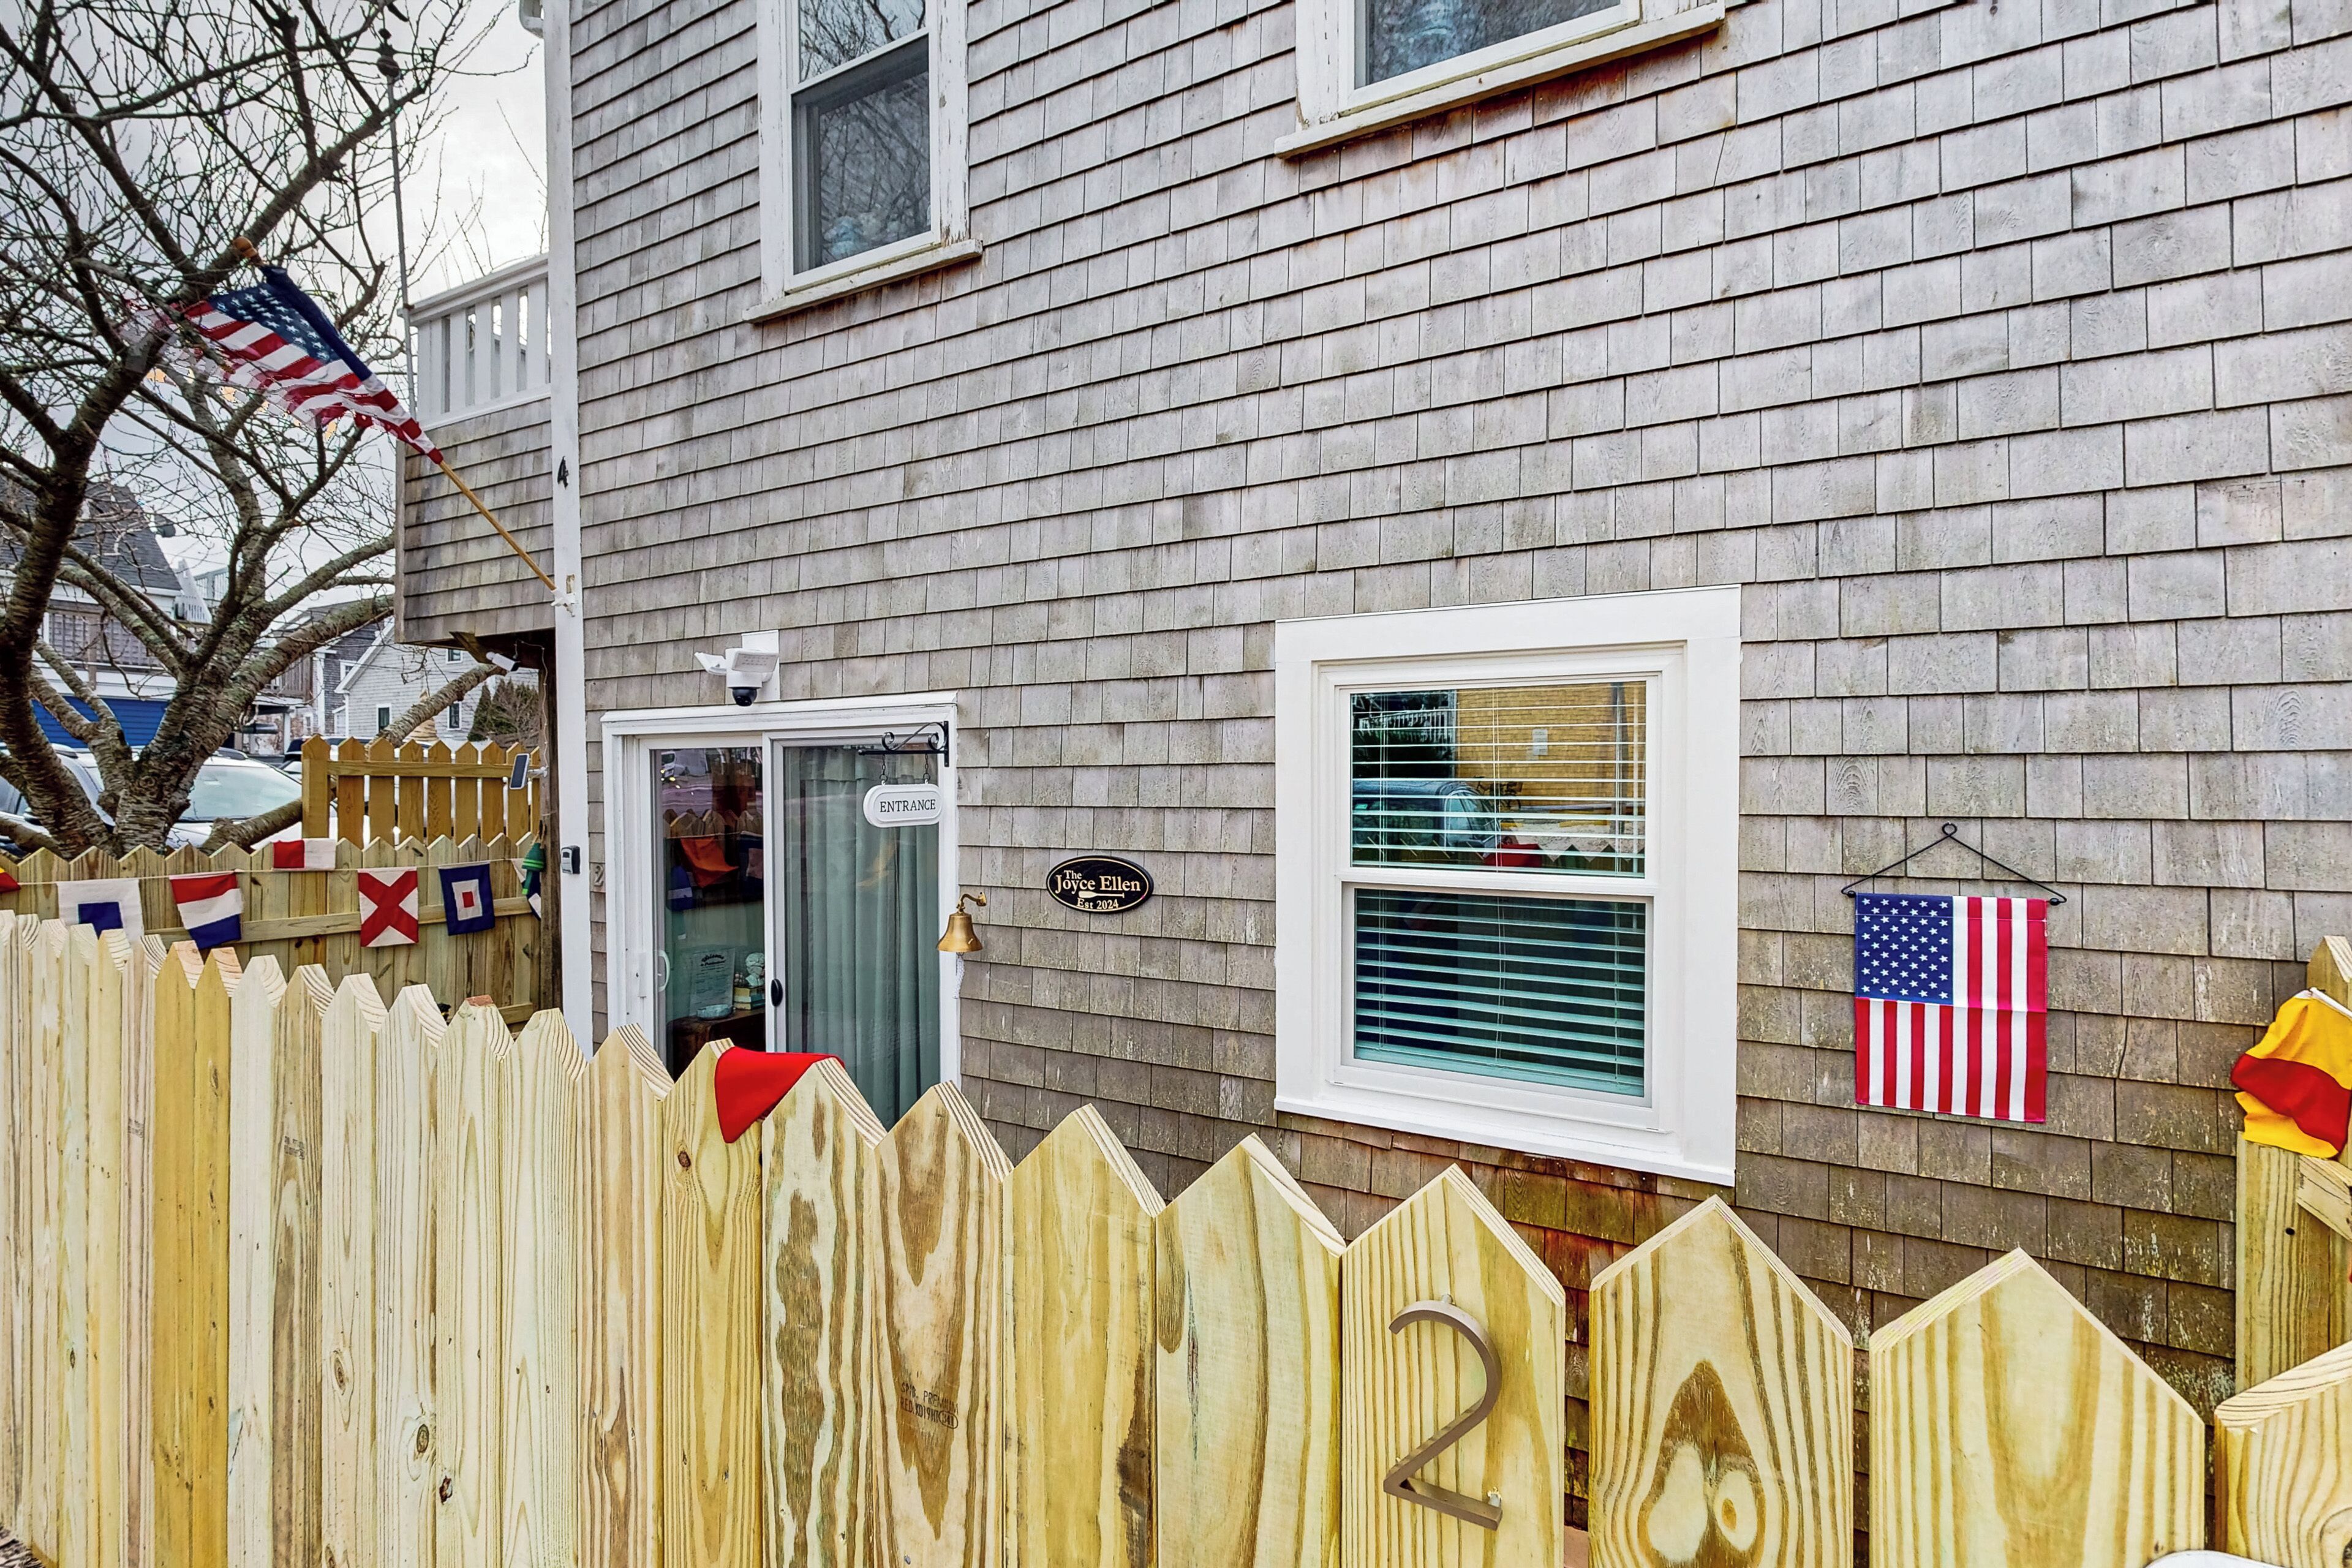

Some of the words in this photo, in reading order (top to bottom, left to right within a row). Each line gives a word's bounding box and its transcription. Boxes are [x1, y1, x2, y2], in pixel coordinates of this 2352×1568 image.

[880, 799, 936, 813] ENTRANCE
[594, 864, 604, 887] 2
[1064, 870, 1082, 880] The
[1055, 875, 1096, 894] Joyce
[1099, 875, 1141, 891] Ellen
[1077, 897, 1093, 909] Est
[1096, 899, 1119, 910] 2024
[1384, 1299, 1502, 1531] 2
